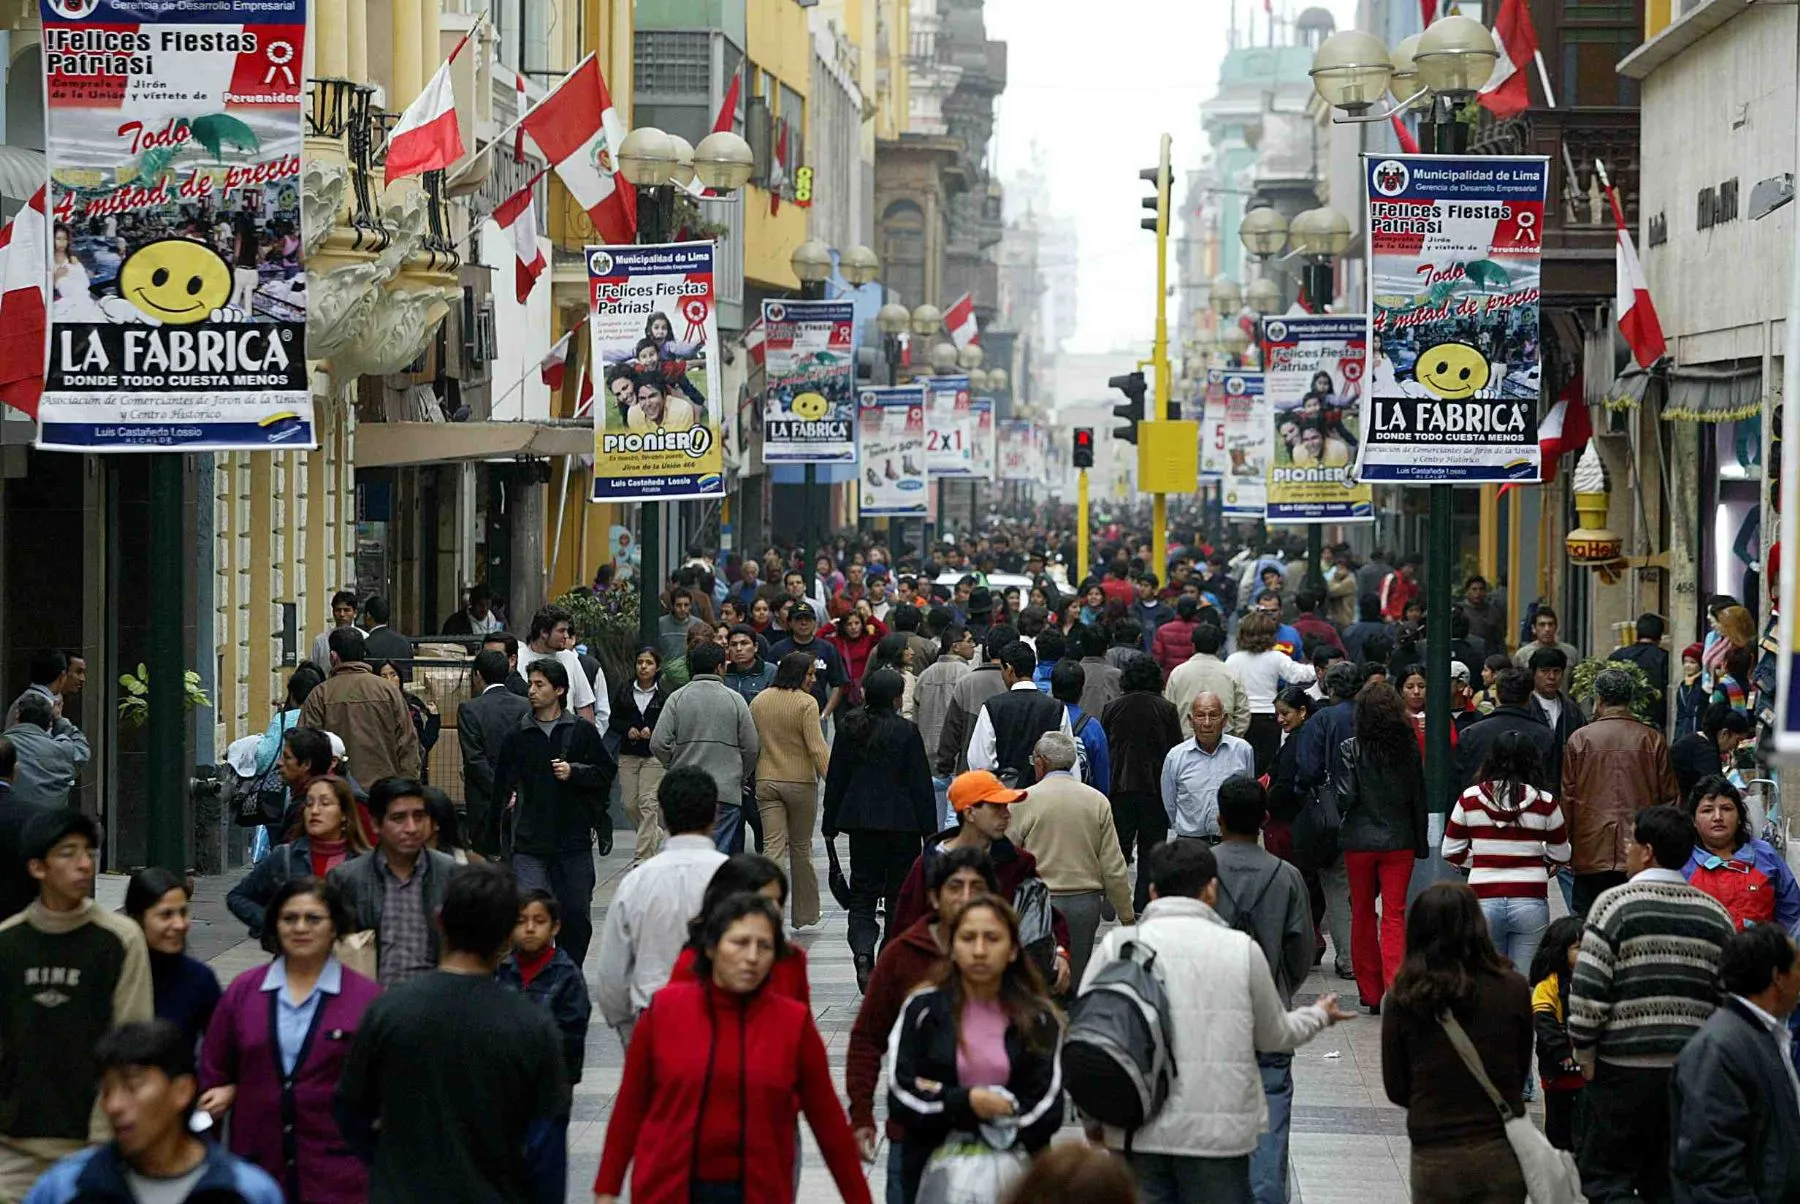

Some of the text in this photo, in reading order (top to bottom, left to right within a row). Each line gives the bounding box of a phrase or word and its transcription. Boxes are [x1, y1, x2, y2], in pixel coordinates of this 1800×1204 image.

[161, 0, 175, 10] de
[178, 0, 231, 10] Desarrollo
[233, 0, 296, 11] Empresarial
[161, 32, 256, 51] Fiestas
[133, 79, 167, 89] Jirón
[52, 90, 66, 99] de
[72, 90, 83, 99] la
[132, 93, 139, 101] y
[193, 91, 208, 100] de
[118, 118, 192, 154] Todo
[1413, 169, 1540, 182] Municipalidad de Lima
[54, 153, 301, 223] A mitad de precio
[1415, 183, 1538, 193] Gerencia de Desarrollo Empresarial
[1448, 205, 1511, 219] Fiestas
[1487, 244, 1541, 254] Peruanidad
[615, 252, 710, 265] Municipalidad de Lima
[1417, 262, 1466, 286] Todo
[656, 282, 707, 296] Fiestas
[598, 301, 655, 314] Patrias!
[1373, 287, 1541, 332] A mitad de precio
[61, 329, 290, 373] LA FABRICA
[1320, 347, 1363, 358] Fiestas
[64, 374, 289, 386] DONDE TODO CUESTA MENOS
[103, 394, 117, 405] de
[196, 394, 209, 405] de
[244, 393, 256, 405] de
[260, 393, 271, 405] la
[120, 411, 128, 422] y
[130, 409, 168, 419] Centro
[1375, 402, 1526, 432] LA FABRICA
[94, 427, 116, 437] Luis
[170, 426, 203, 437] Lossio
[771, 421, 847, 437] LA FABRICA
[1376, 432, 1412, 440] DONDE
[1445, 433, 1485, 441] CUESTA
[611, 479, 626, 487] Luis
[668, 477, 691, 485] Lossio
